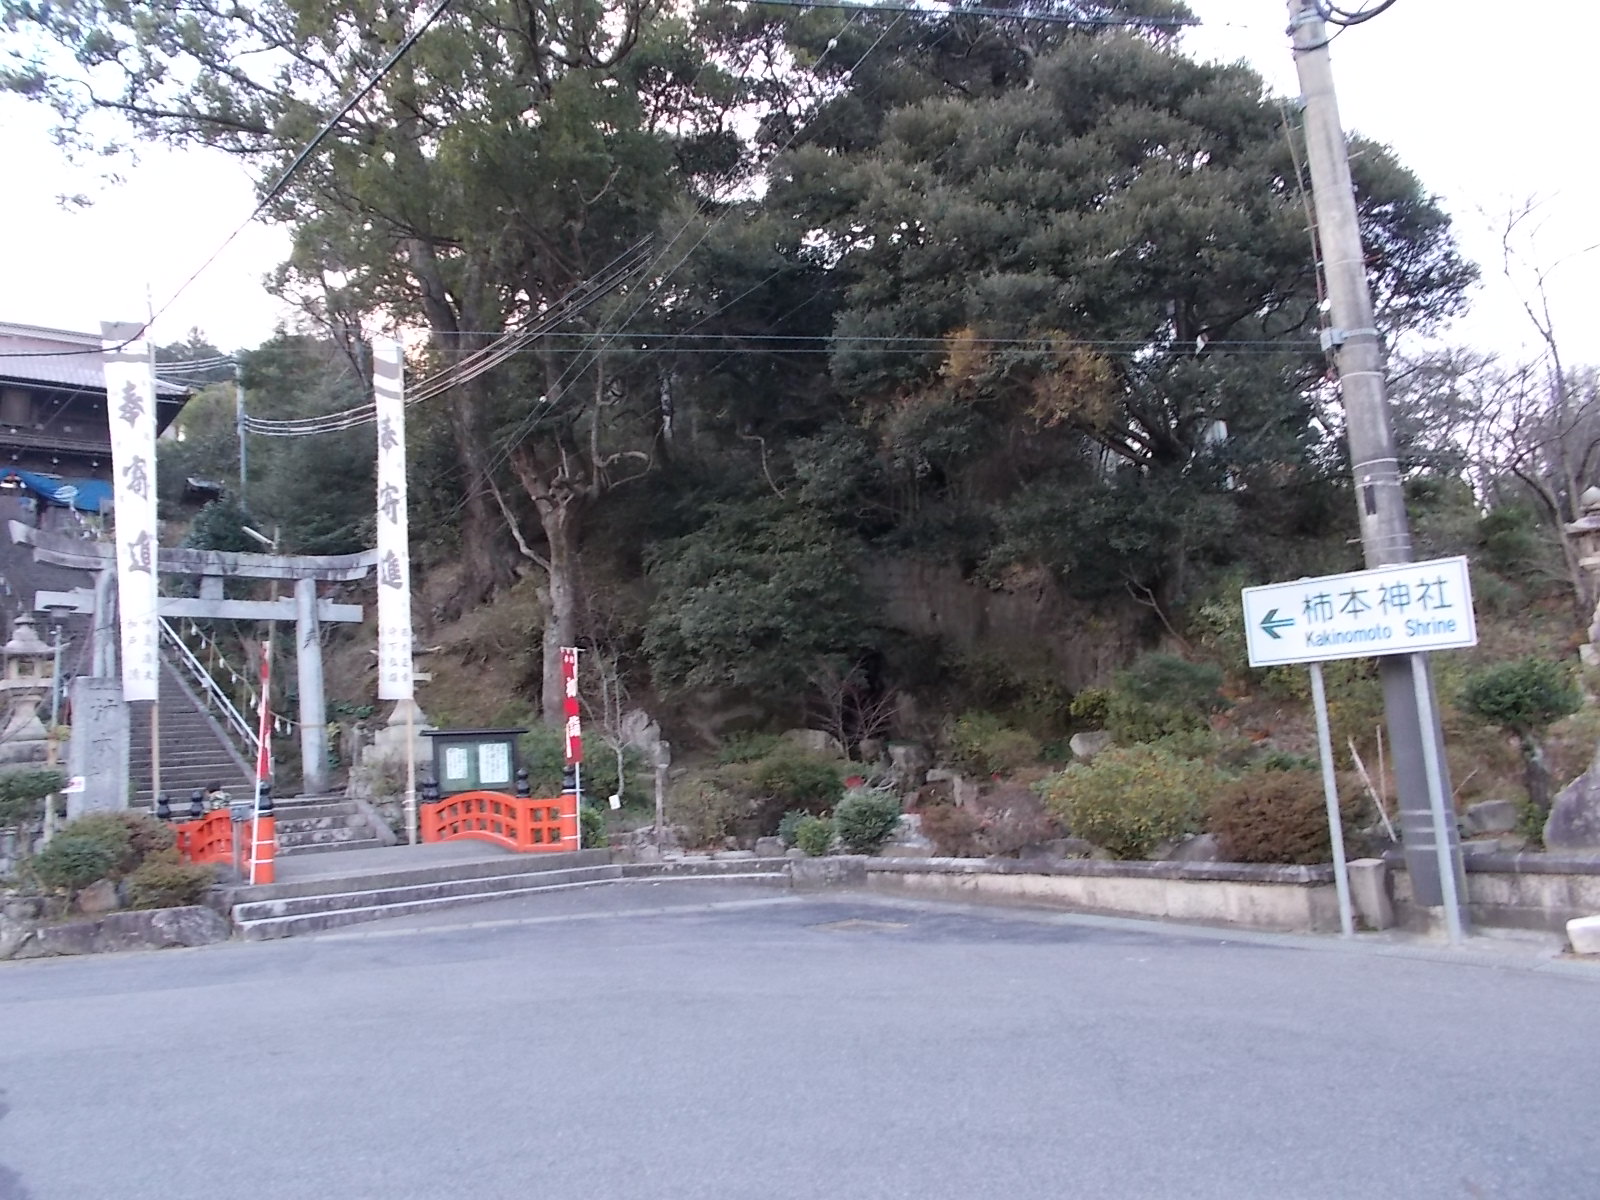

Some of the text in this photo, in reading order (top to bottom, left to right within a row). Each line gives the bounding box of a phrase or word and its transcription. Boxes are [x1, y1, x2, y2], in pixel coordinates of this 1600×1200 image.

[1303, 575, 1453, 624] 柿本神社
[1305, 618, 1456, 647] Kakinomoto Shrine
